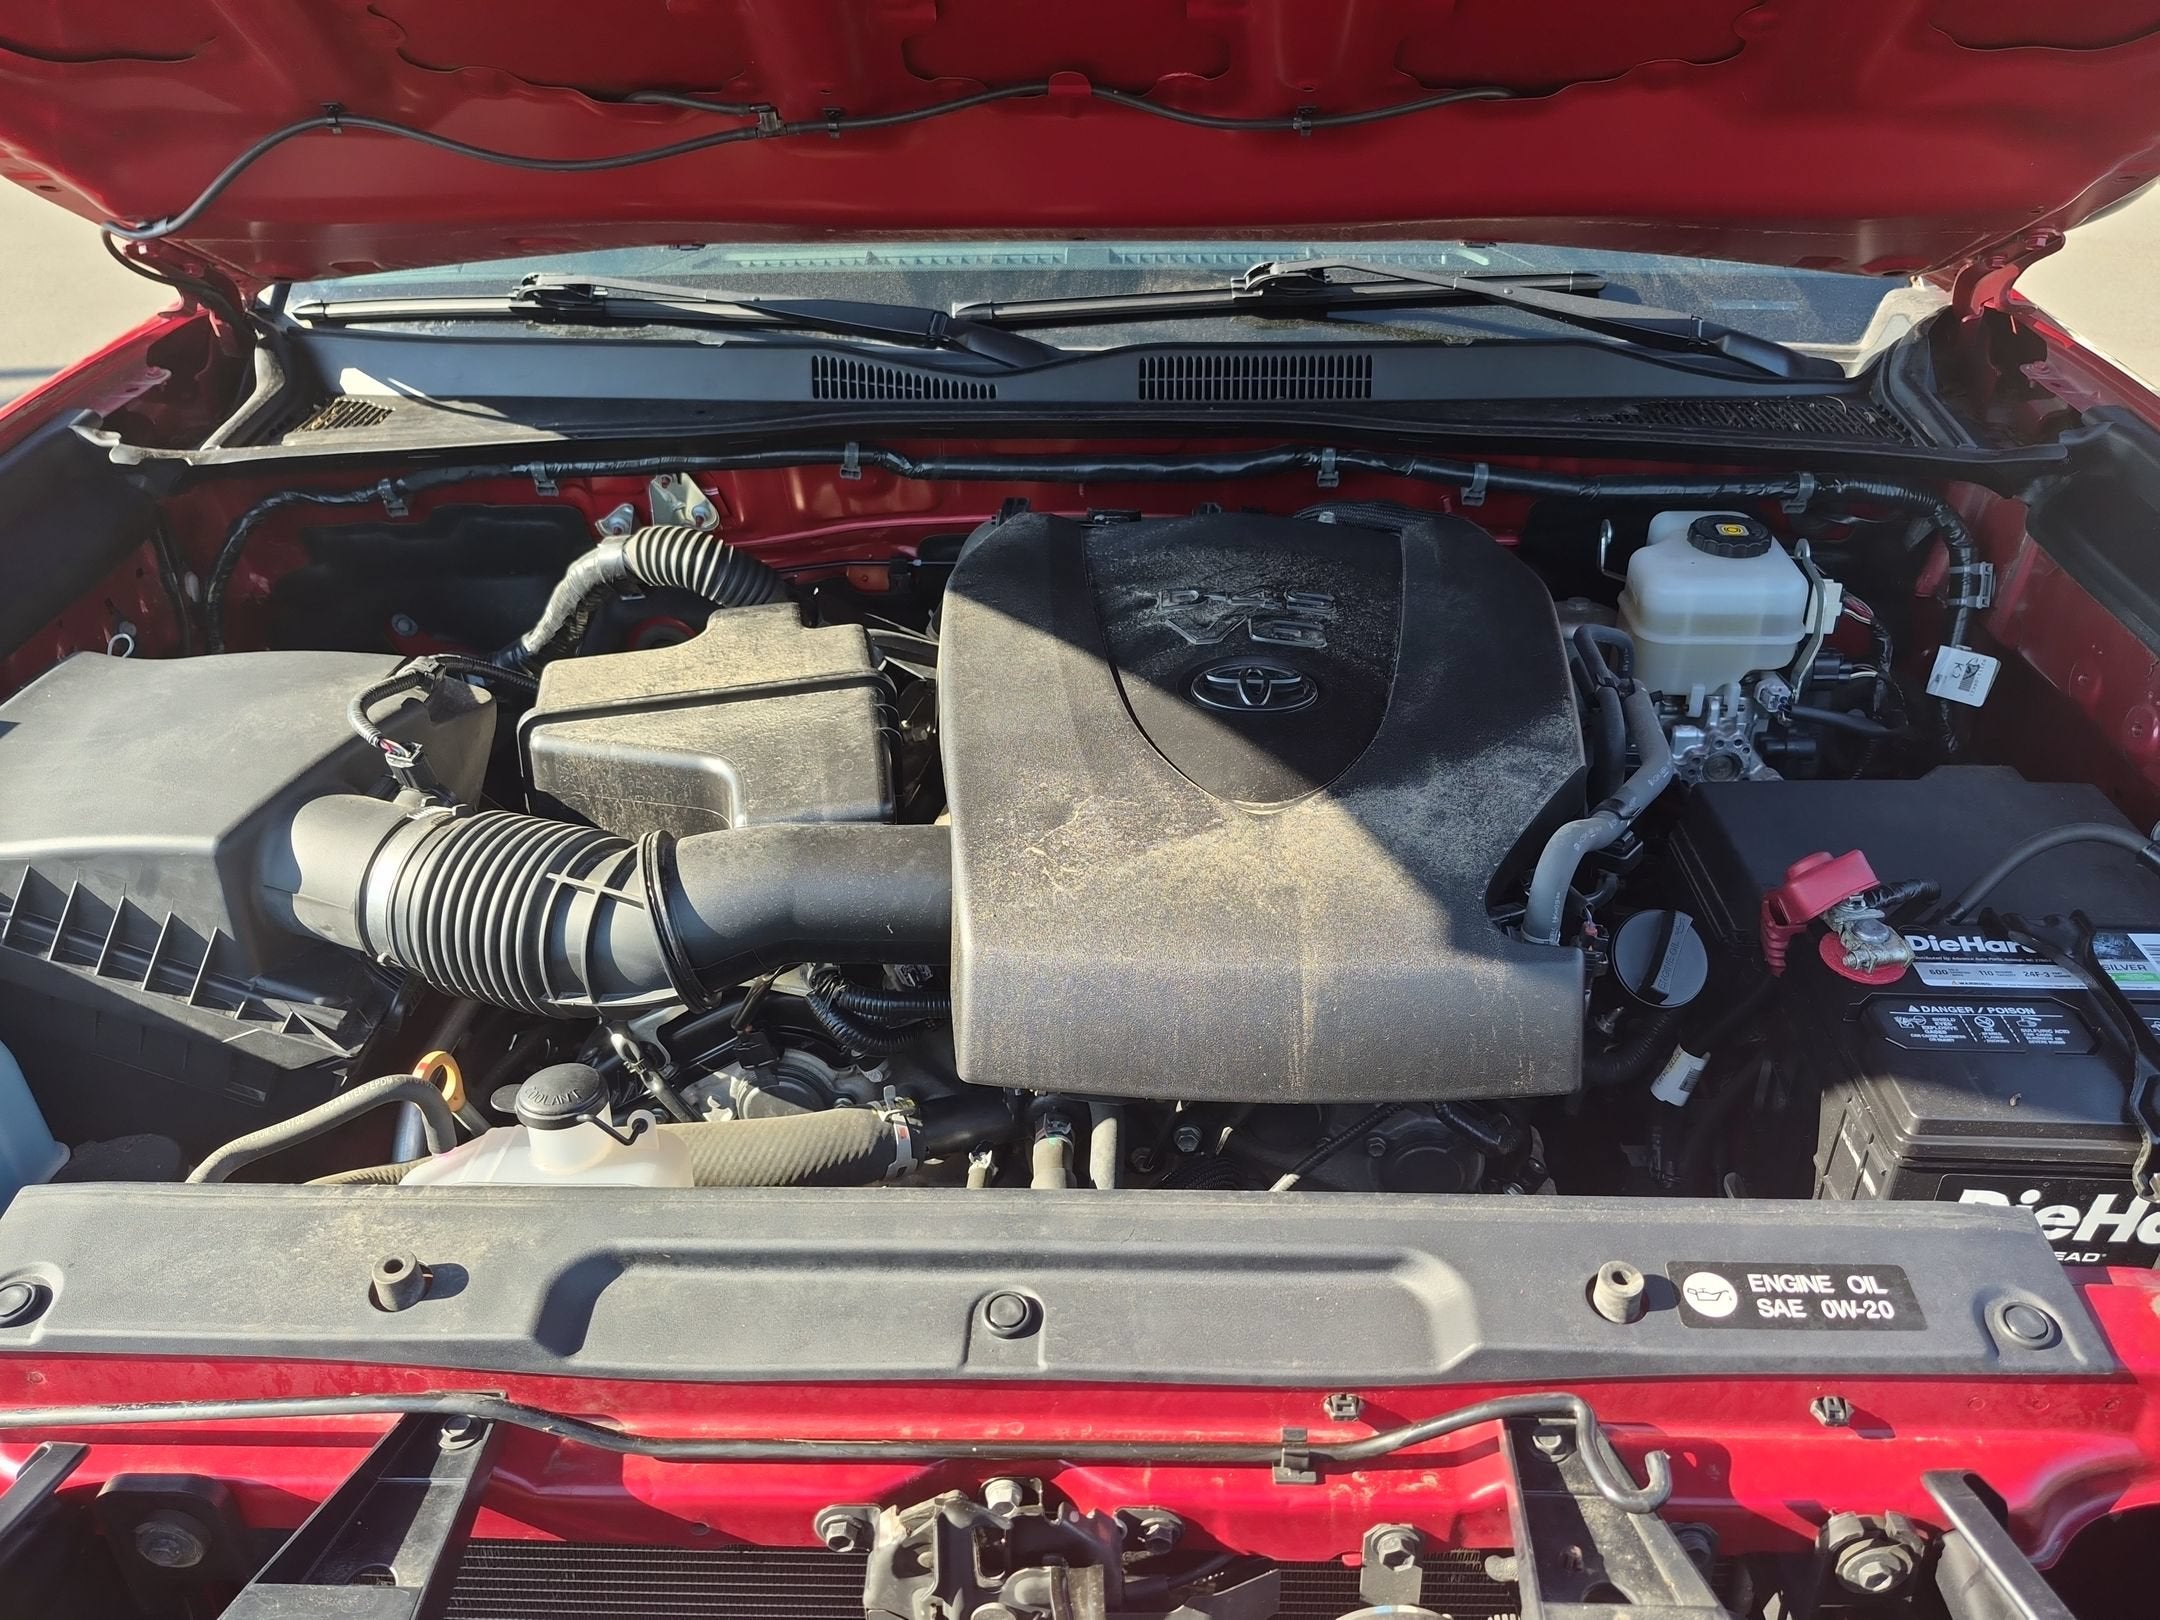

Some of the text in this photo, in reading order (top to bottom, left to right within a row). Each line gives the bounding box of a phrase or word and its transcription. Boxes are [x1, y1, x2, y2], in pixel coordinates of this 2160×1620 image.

[1154, 585, 1338, 618] D-4S
[1163, 613, 1329, 649] V6
[1978, 969, 1994, 977] 110
[2102, 963, 2148, 972] SILVER
[1920, 1005, 1975, 1014] DANGER
[1987, 1007, 2037, 1015] POISON
[524, 1085, 584, 1106] COOLANT
[1747, 1273, 1890, 1296] ENGINE OIL
[1756, 1298, 1896, 1321] SAE 0W-20
